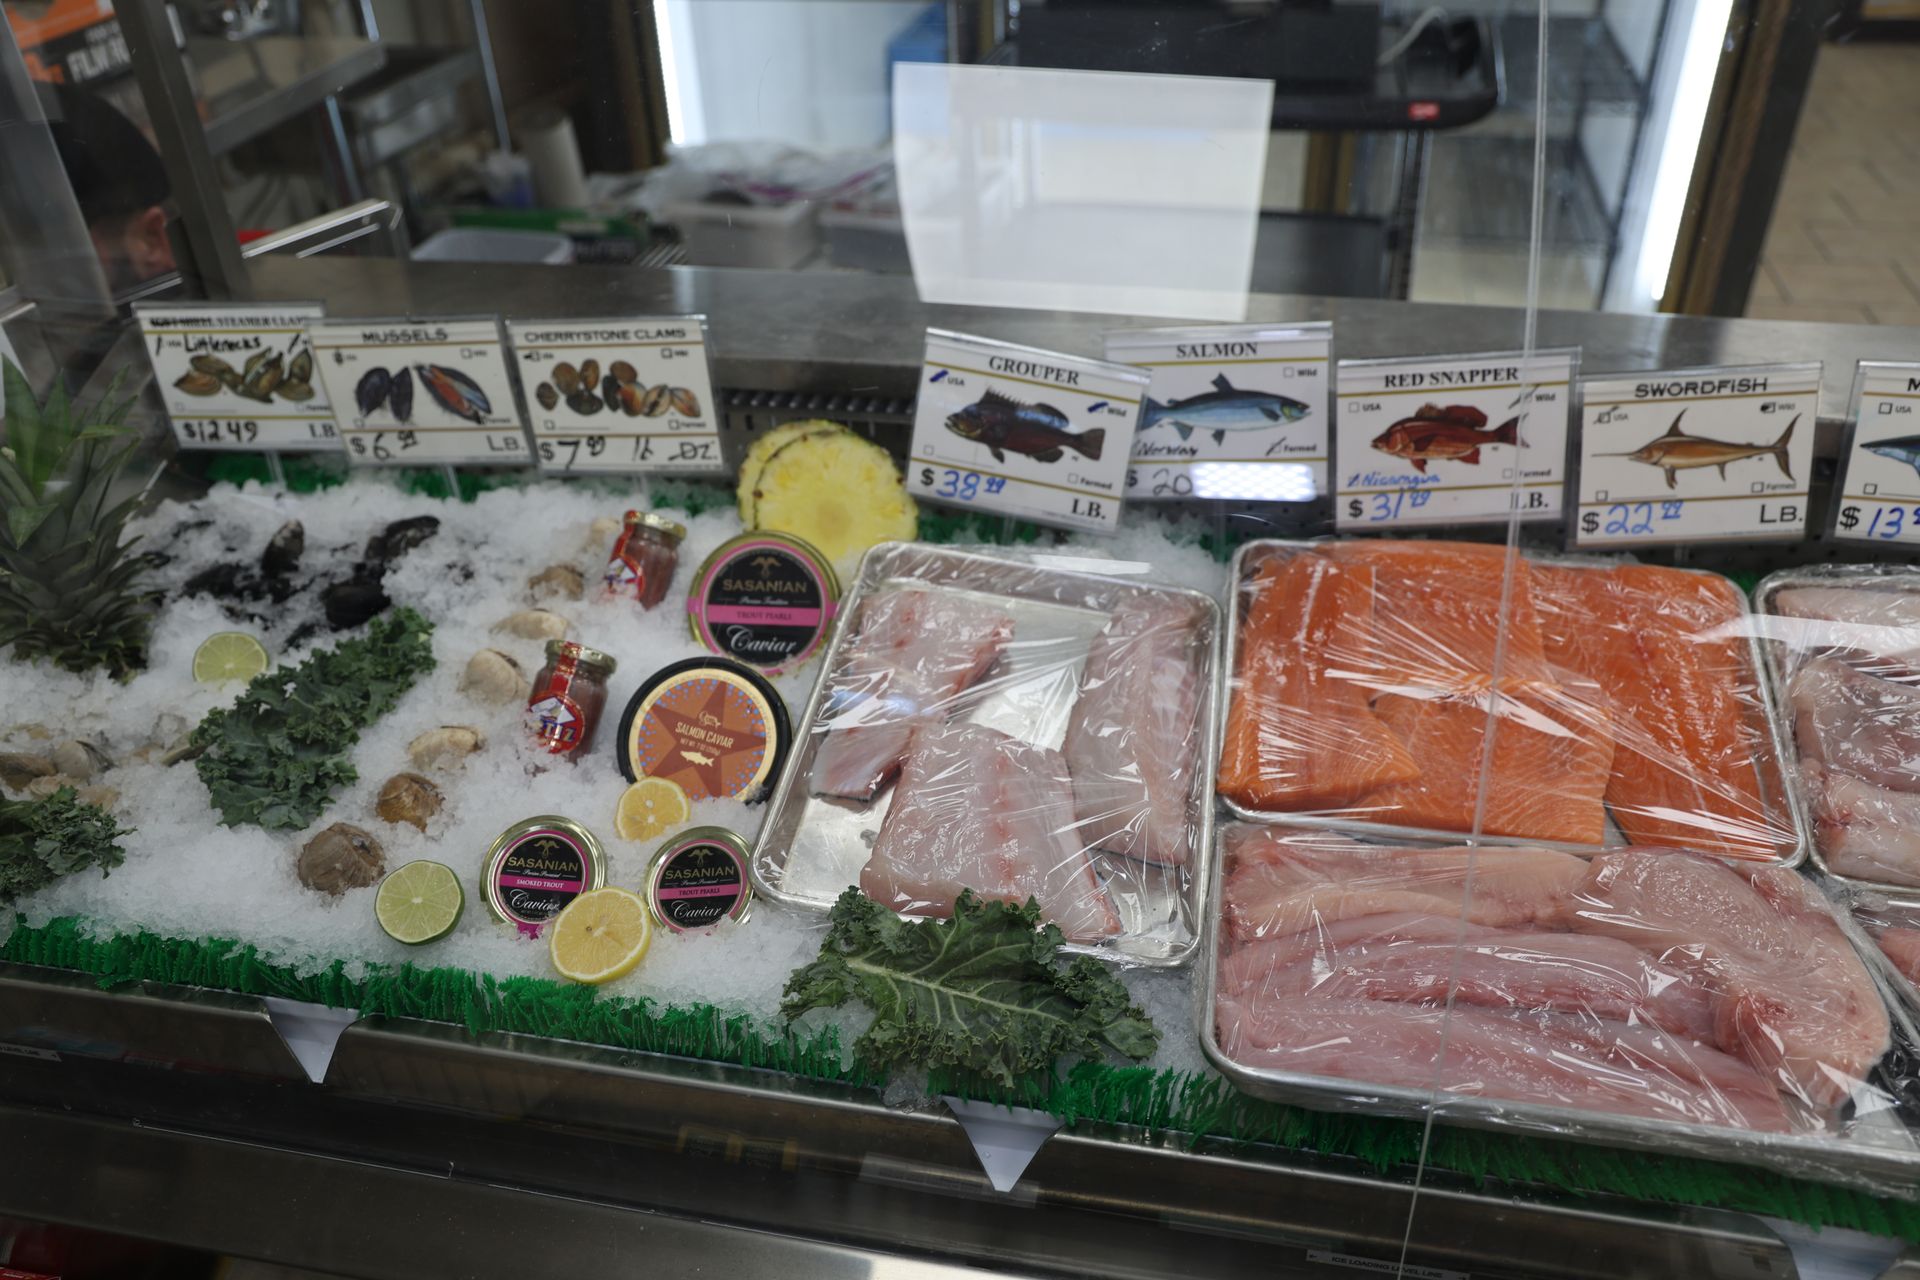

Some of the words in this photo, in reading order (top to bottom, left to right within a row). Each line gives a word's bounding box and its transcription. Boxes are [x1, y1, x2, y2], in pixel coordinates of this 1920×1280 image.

[362, 328, 448, 343] MUSSELS
[524, 329, 631, 343] CHERRYSTONE
[634, 328, 686, 340] CLAMS
[1176, 342, 1258, 358] SALMON
[989, 355, 1080, 385] GROUPER
[1384, 372, 1424, 388] RED
[1429, 366, 1519, 386] SNAPPER
[947, 376, 965, 386] USA
[1634, 378, 1768, 399] SWORDFISH
[1535, 393, 1556, 402] Wild
[1107, 406, 1127, 417] Wild
[1362, 402, 1381, 412] USA
[486, 434, 525, 452] LB.
[1072, 498, 1106, 520] LB.
[1759, 503, 1803, 523] LB.
[723, 579, 807, 593] SASANIAN
[726, 625, 797, 652] Caviar
[675, 722, 707, 740] SALMON
[706, 731, 734, 748] CAVIAR
[508, 856, 579, 872] SASANIAN
[665, 866, 735, 880] SASANIAN
[516, 879, 543, 887] SMOKED
[543, 881, 565, 889] TROUT
[509, 889, 560, 911] Caviar
[671, 900, 722, 919] Caviar
[1349, 1259, 1389, 1270] LOADING
[1422, 1269, 1443, 1278] LINE
